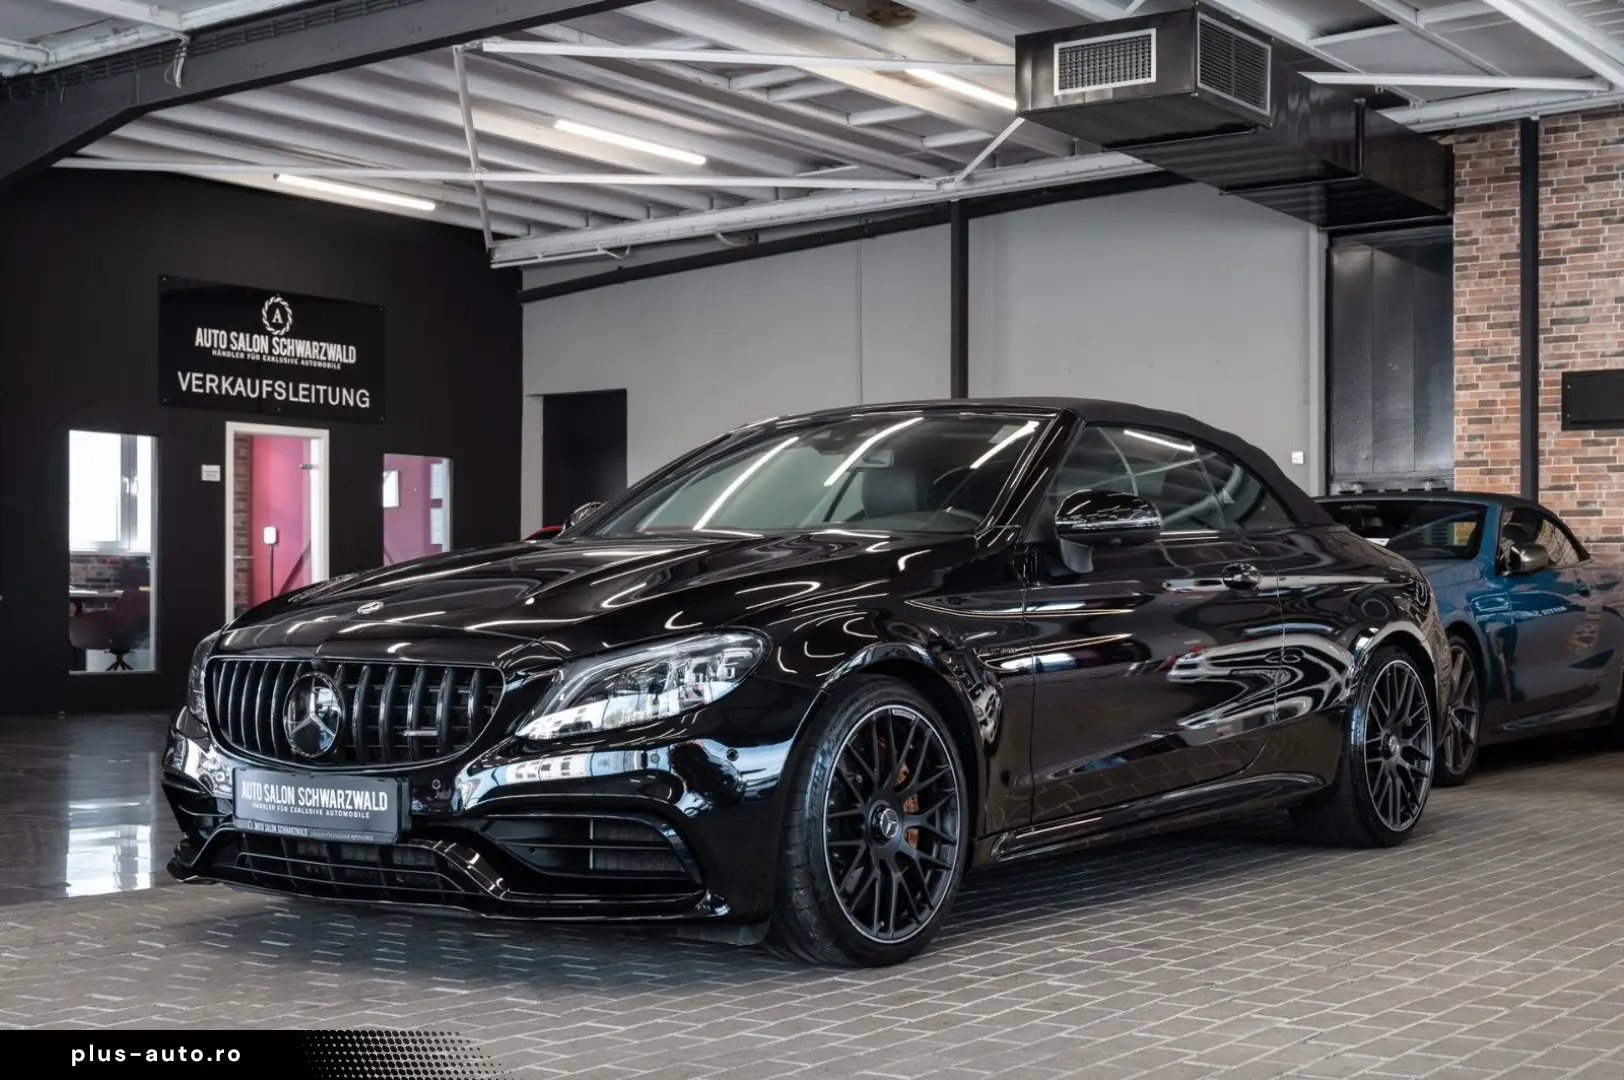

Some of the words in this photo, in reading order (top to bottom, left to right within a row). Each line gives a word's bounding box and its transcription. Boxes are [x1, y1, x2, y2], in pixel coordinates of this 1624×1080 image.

[272, 308, 283, 324] A
[195, 327, 227, 348] AUTO
[230, 332, 269, 354] SALON
[272, 337, 357, 363] SCHWARZWALD
[212, 348, 245, 359] HÄNDLER
[247, 353, 261, 361] FÜR
[263, 355, 298, 365] EXKLUSIVE
[301, 359, 341, 370] AUTOMOBILE
[177, 371, 370, 408] VERKAUFSLEITUNG
[241, 780, 263, 800] AUTO
[264, 784, 295, 804] SALON
[297, 787, 388, 811] SCHWARZWALD
[290, 807, 323, 816] EXKLUSIVE
[325, 810, 370, 819] AUTOMOBILE
